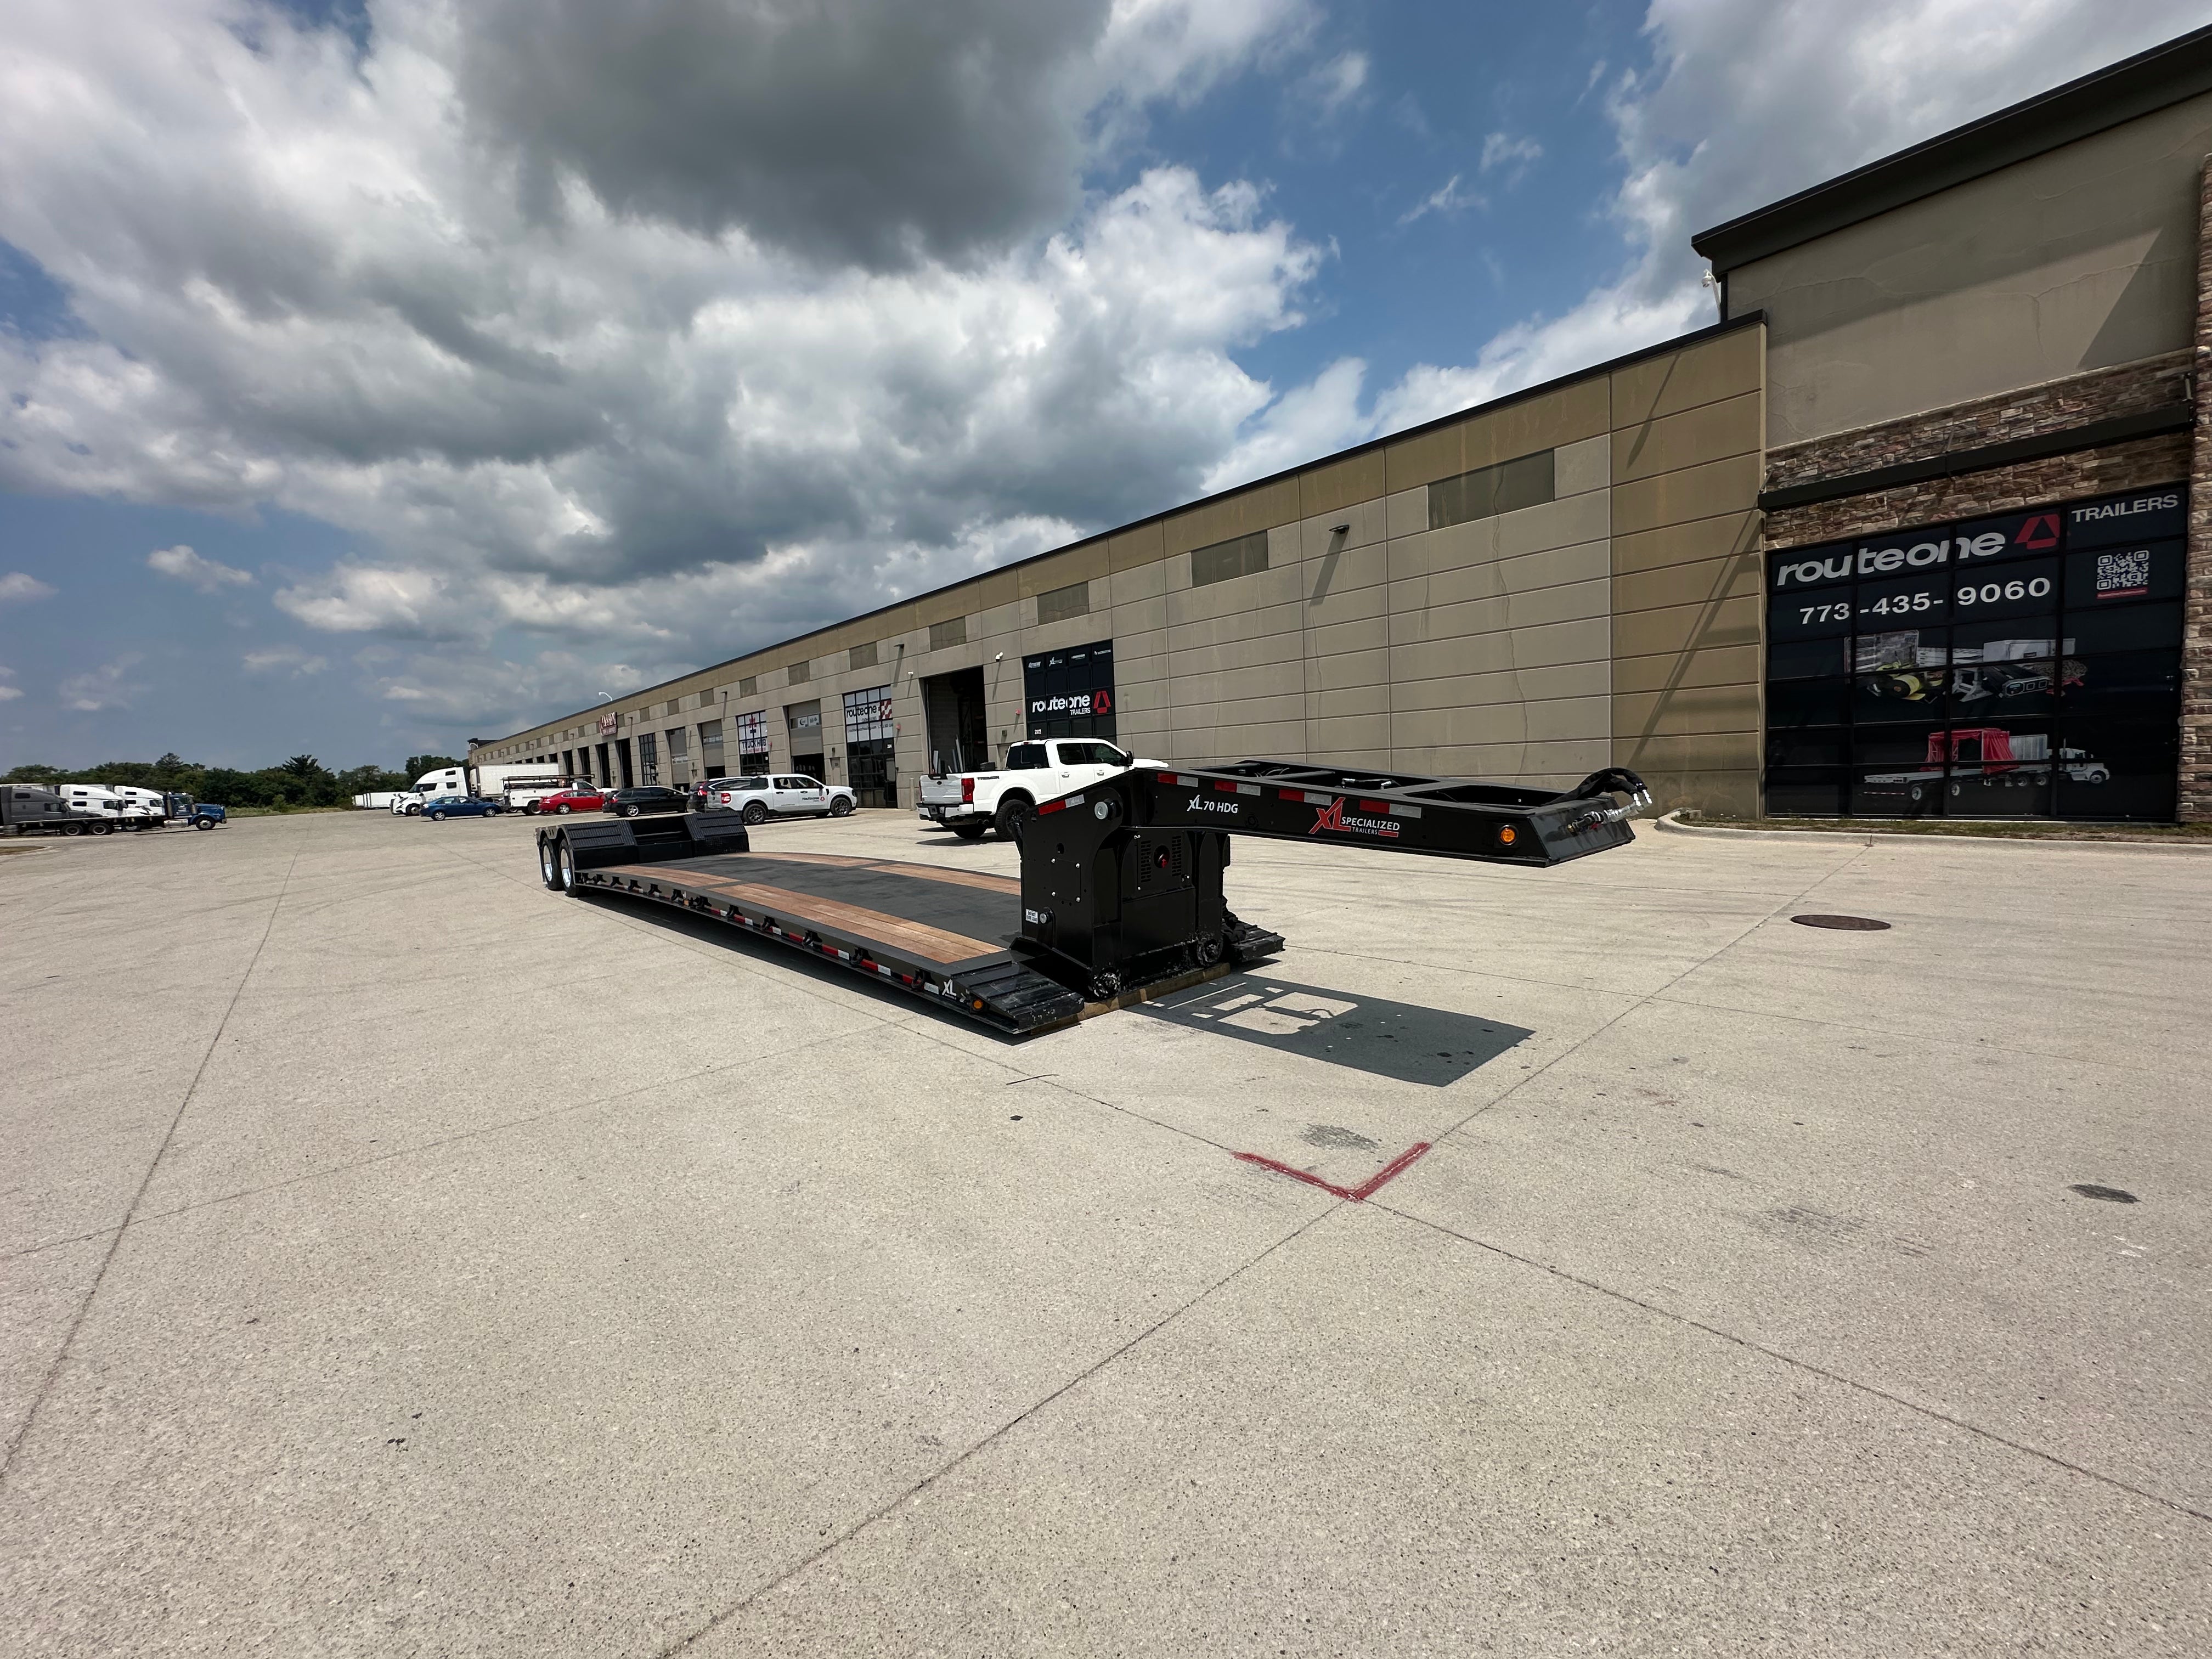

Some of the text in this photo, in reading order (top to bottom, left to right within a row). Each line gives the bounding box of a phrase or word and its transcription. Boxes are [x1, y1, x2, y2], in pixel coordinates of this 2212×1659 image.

[2071, 494, 2179, 523] TRAILERS
[1776, 532, 2006, 586] routeone
[1032, 695, 1091, 713] routeone
[1070, 707, 1091, 715] TRAILERS
[1216, 802, 1239, 814] HDG
[1308, 797, 1400, 834] XL SPECIALIZED
[1352, 826, 1378, 835] TRAILERS
[941, 979, 957, 996] XL
